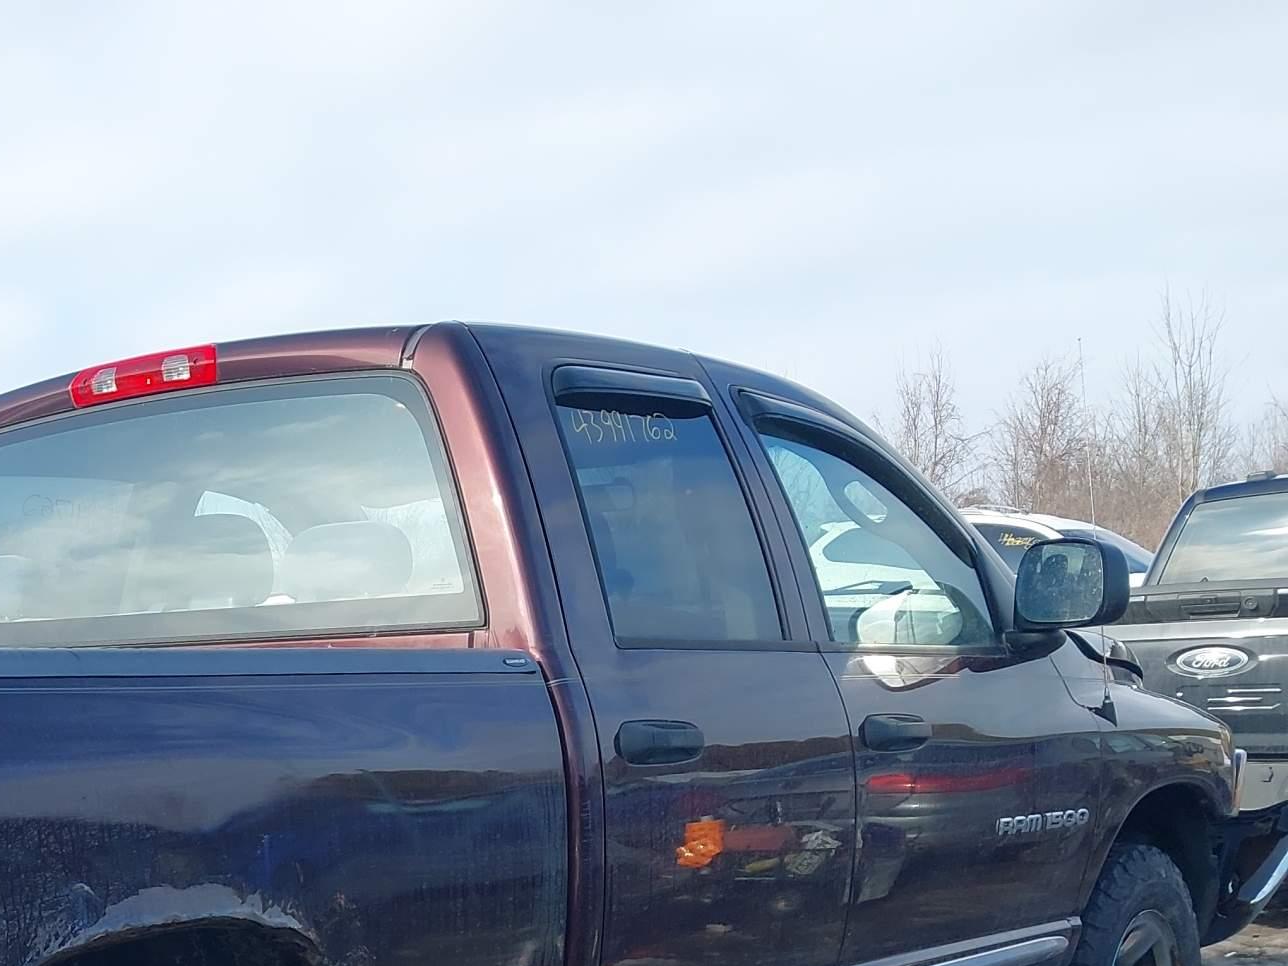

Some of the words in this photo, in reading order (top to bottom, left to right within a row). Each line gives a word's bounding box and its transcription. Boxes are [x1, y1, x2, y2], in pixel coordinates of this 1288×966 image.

[570, 408, 677, 445] 43991762
[997, 813, 1042, 836] RAM
[1045, 808, 1089, 830] 1500
